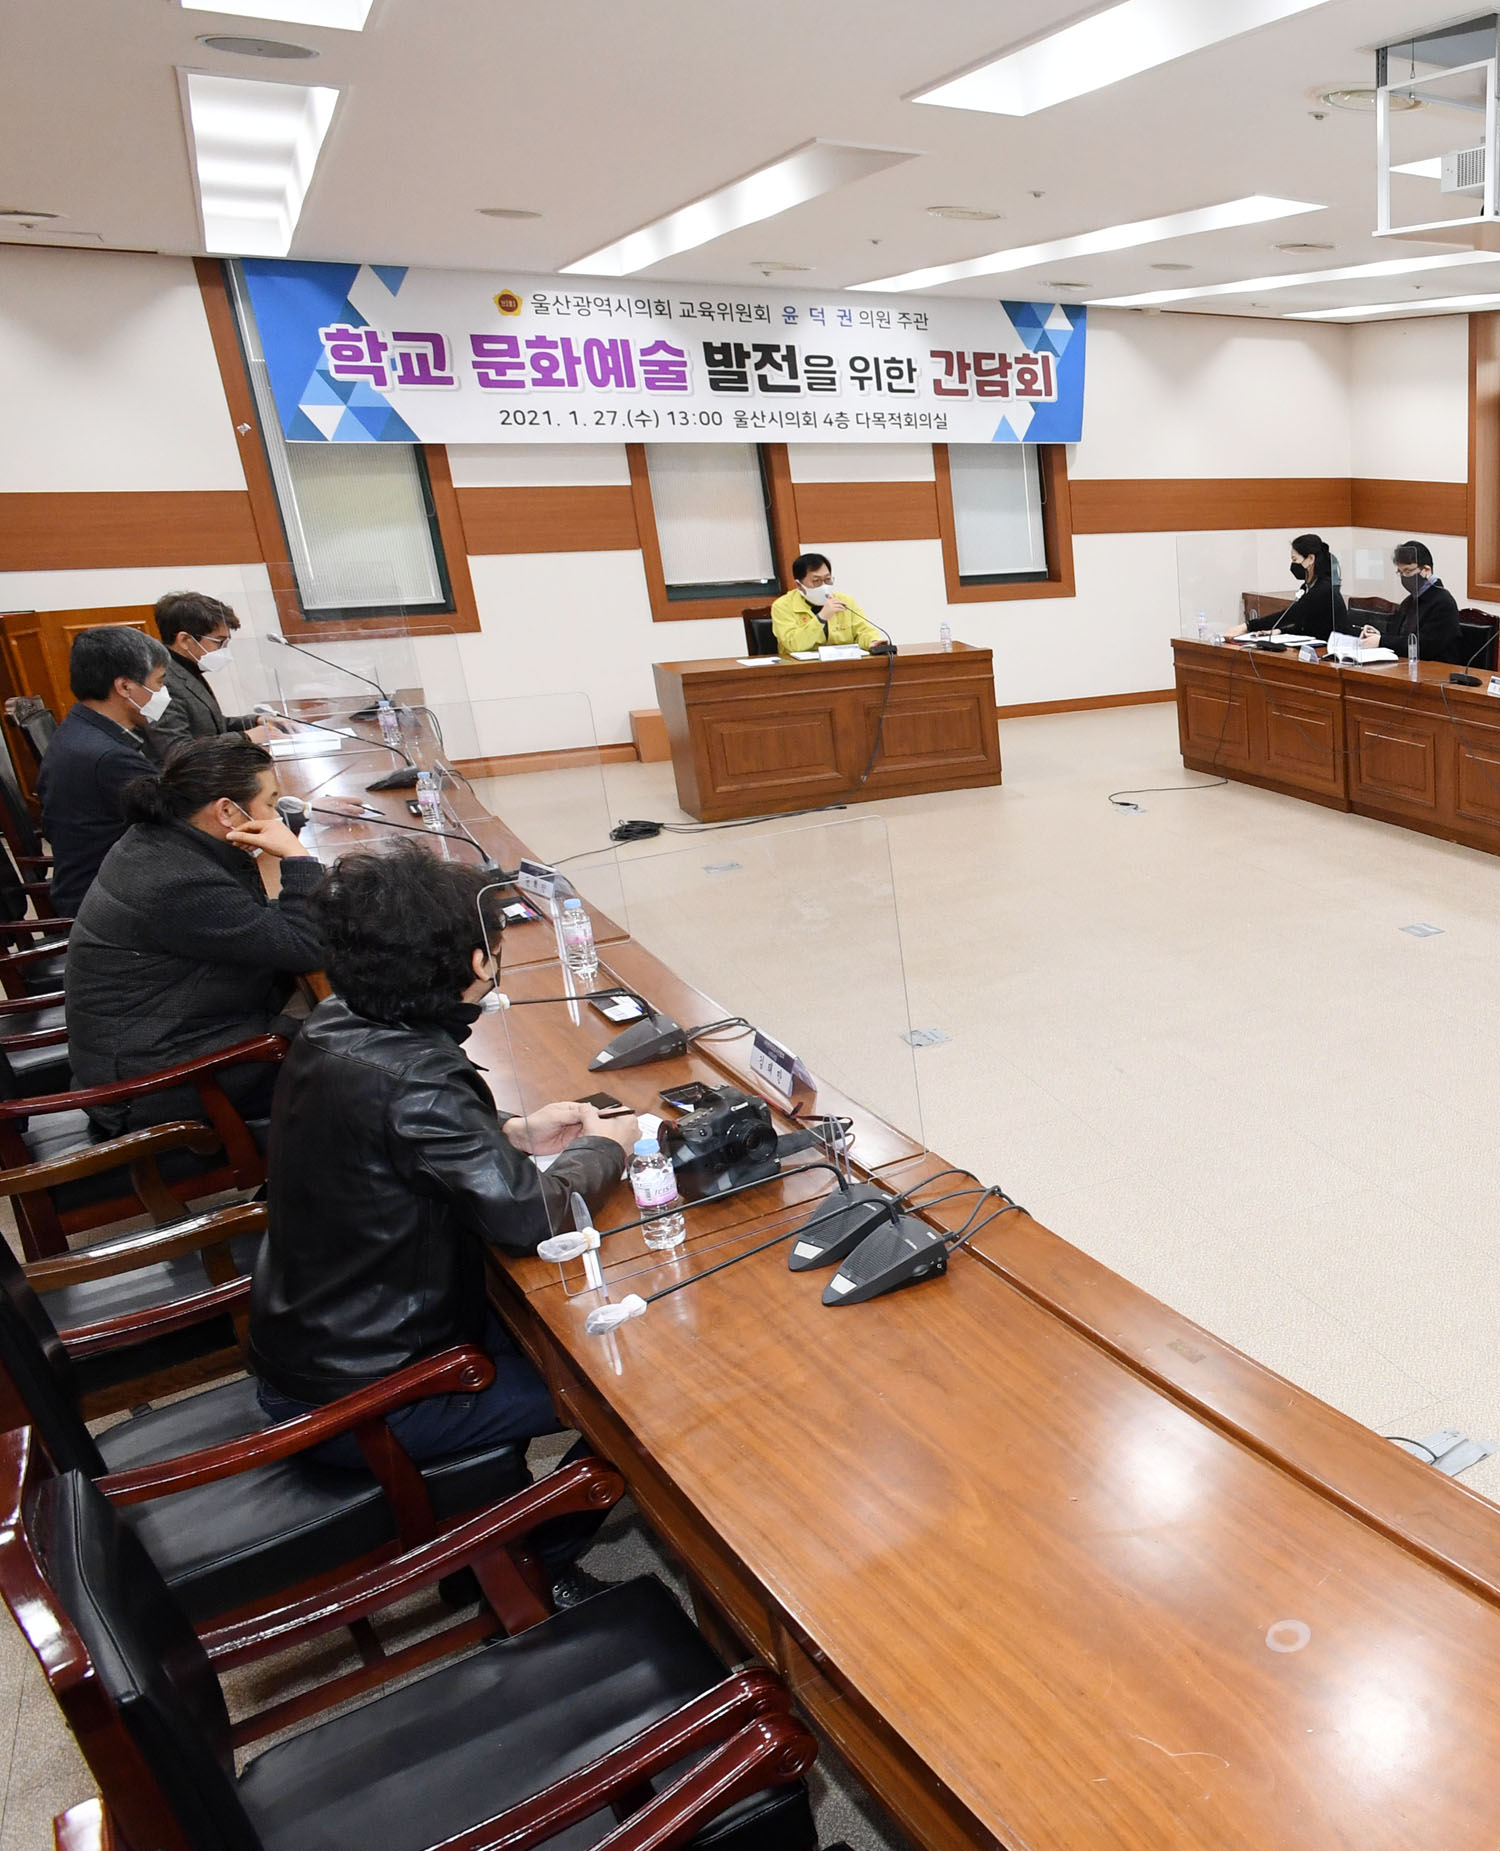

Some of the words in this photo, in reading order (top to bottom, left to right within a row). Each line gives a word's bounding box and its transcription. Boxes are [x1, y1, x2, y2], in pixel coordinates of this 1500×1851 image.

[531, 293, 672, 320] 울산광역시의회
[680, 302, 770, 324] 교육위원회
[782, 306, 799, 325] 윤
[809, 307, 826, 326] 덕
[836, 308, 853, 328] 권
[859, 310, 892, 329] 의원
[897, 312, 929, 331] 주관
[324, 328, 454, 387] 학교
[469, 333, 688, 391] 문화예술
[702, 341, 837, 393] 발전을
[849, 355, 917, 394] 위한
[930, 349, 1053, 397] 간담회
[499, 410, 560, 426] 2021.
[569, 411, 586, 426] 1.
[667, 411, 722, 426] 13:00
[733, 410, 817, 428] 울산시의회
[823, 411, 850, 429] 4층
[856, 412, 947, 430] 다목적회의실
